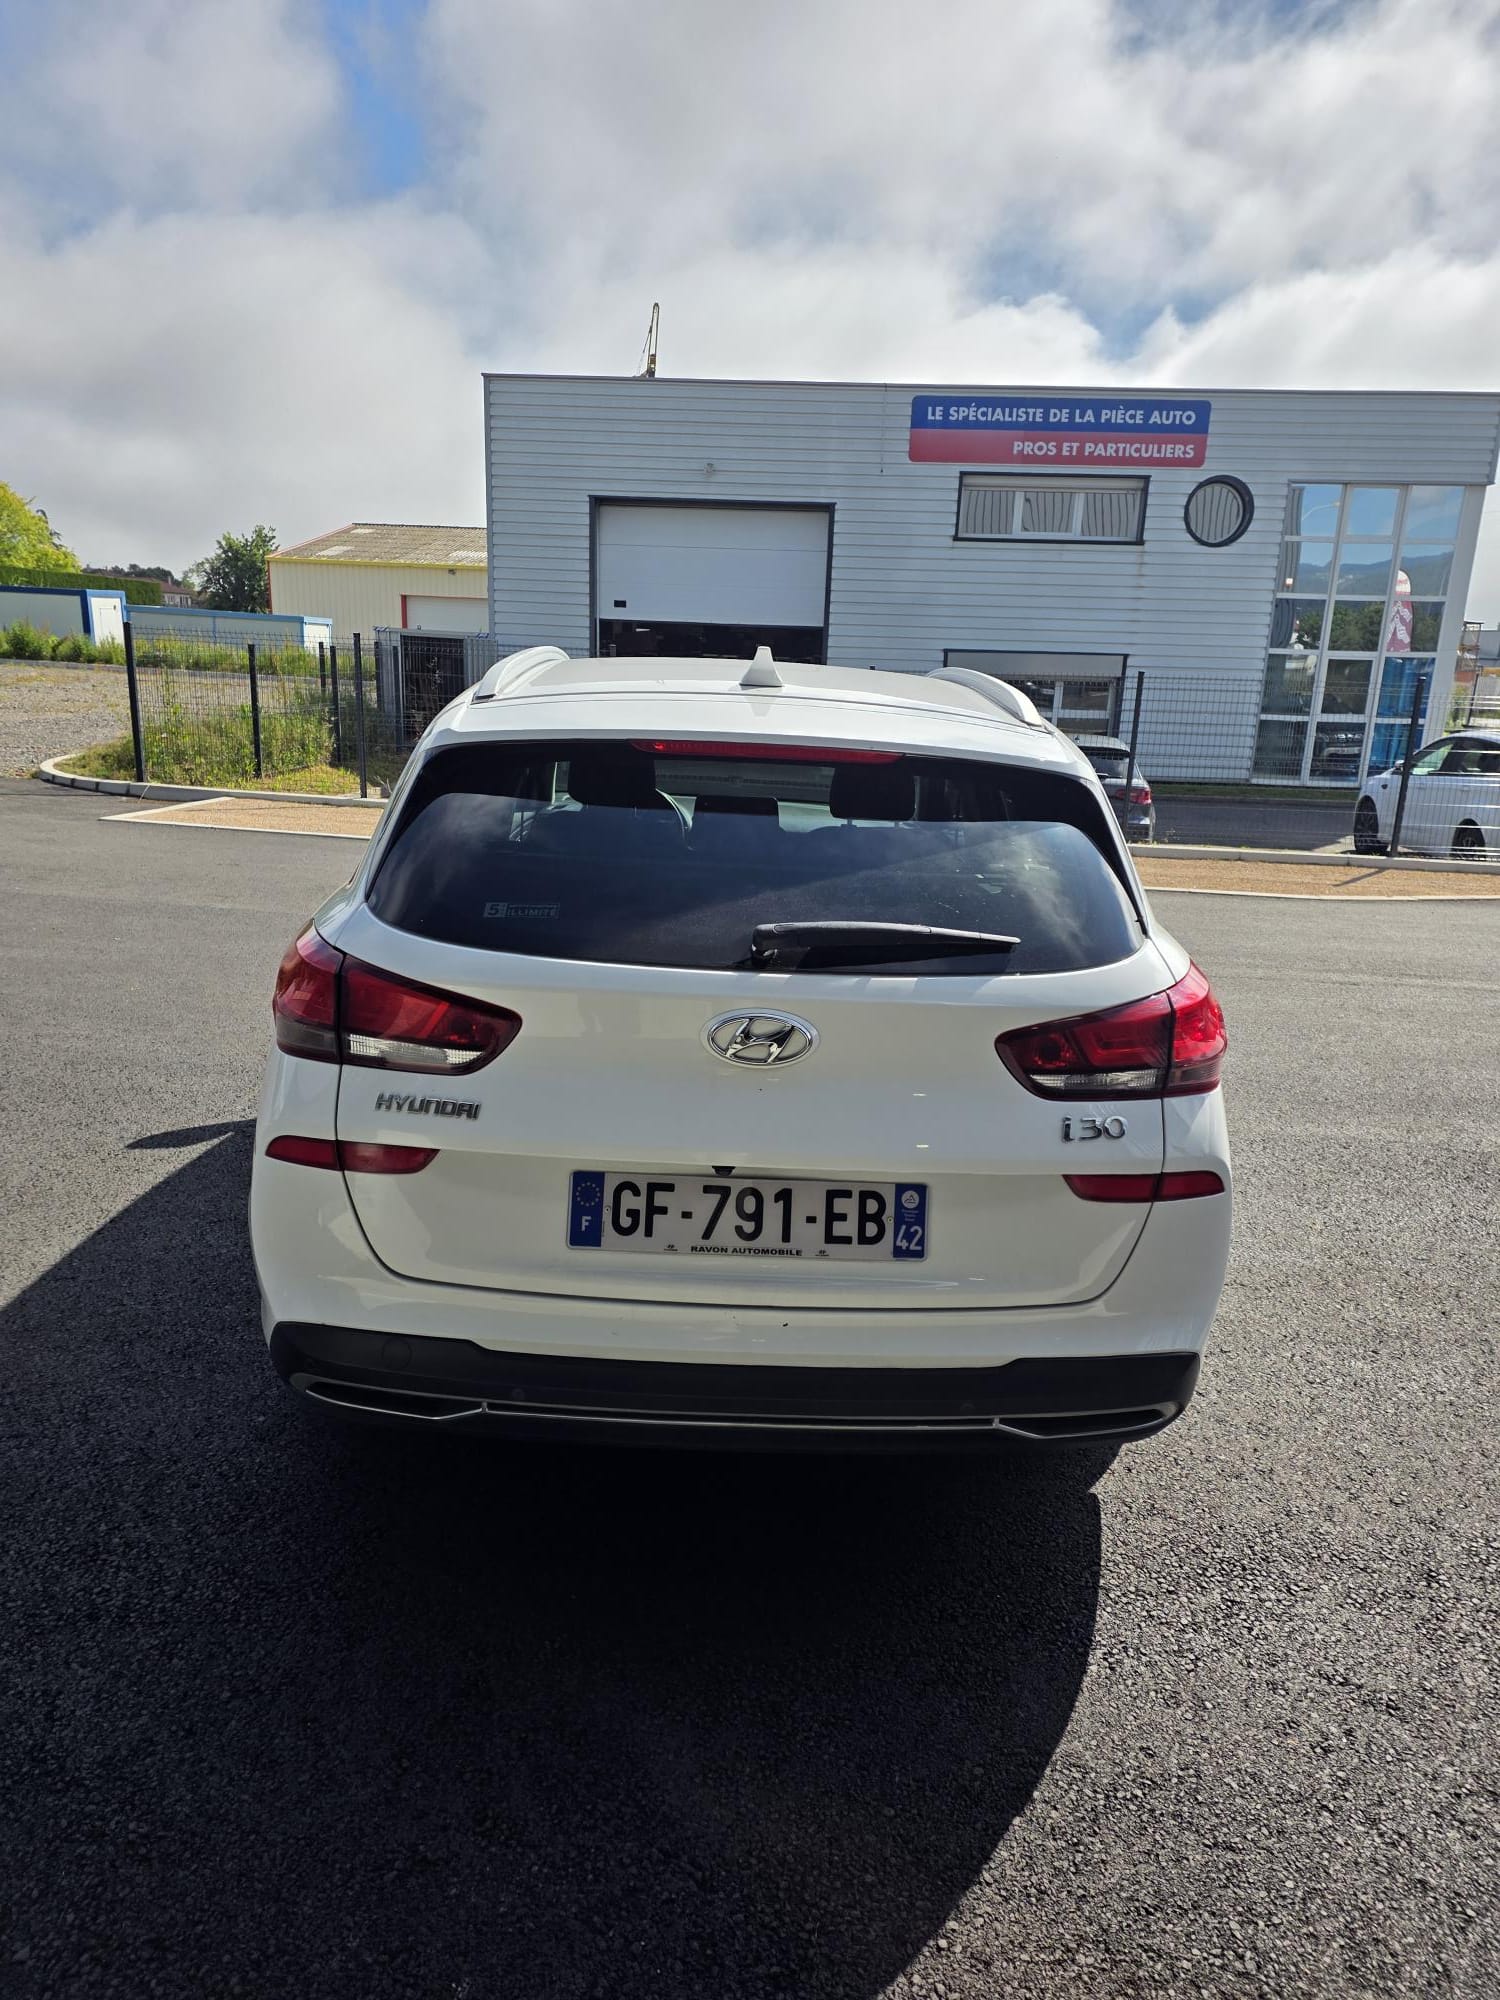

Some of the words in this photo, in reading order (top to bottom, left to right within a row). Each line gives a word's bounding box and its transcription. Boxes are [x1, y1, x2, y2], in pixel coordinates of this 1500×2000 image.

[927, 406, 943, 421] LE
[949, 403, 1044, 422] SPÉCIALISTE
[1049, 408, 1070, 423] DE
[1075, 409, 1095, 424] LA
[1101, 405, 1144, 425] PIÈCE
[1149, 410, 1196, 426] AUTO
[1013, 441, 1057, 456] PROS
[1062, 442, 1081, 456] ET
[1084, 442, 1195, 459] PARTICULIERS
[375, 1093, 482, 1120] HYUNDAI
[1061, 1115, 1128, 1142] i30
[580, 1216, 592, 1232] F
[611, 1180, 887, 1246] GF-791-EB
[895, 1224, 924, 1251] 42
[690, 1245, 728, 1255] RAVON
[731, 1246, 803, 1257] AUTOMOBILE
